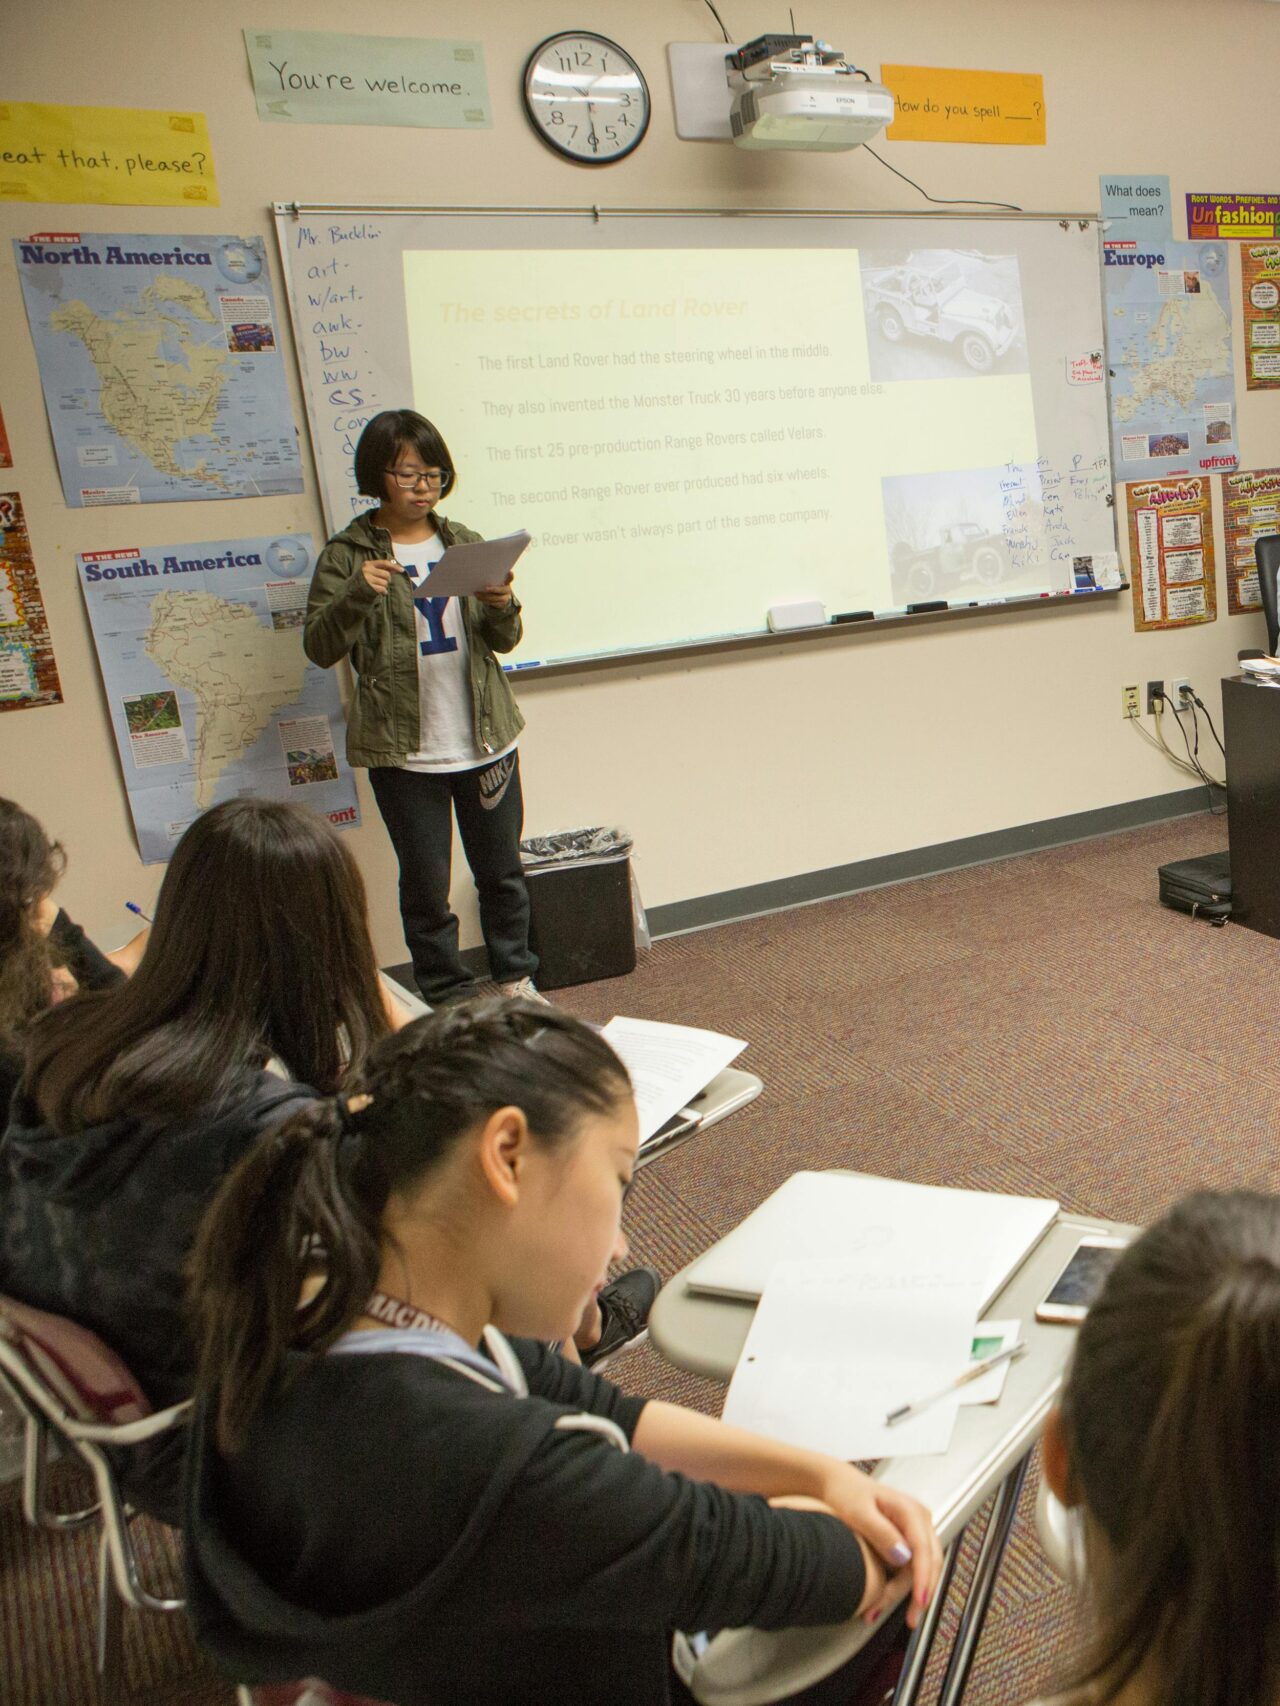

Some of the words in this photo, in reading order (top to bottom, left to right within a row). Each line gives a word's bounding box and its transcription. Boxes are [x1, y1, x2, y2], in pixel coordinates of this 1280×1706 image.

[560, 57, 572, 72] 11
[574, 51, 592, 66] 12
[269, 61, 355, 91] You're
[364, 76, 470, 96] welcome.
[619, 93, 631, 107] 3
[924, 98, 940, 113] do
[945, 106, 968, 120] you
[974, 105, 1000, 122] spell
[551, 111, 564, 125] 8
[618, 113, 627, 126] 4
[567, 125, 578, 138] 7
[605, 125, 617, 139] 5
[0, 147, 47, 164] eat
[126, 152, 206, 176] please?
[1106, 185, 1133, 197] What
[1135, 185, 1161, 197] does
[1191, 195, 1208, 203] ROOT
[1129, 205, 1164, 217] mean?
[20, 246, 102, 265] North
[105, 246, 213, 265] America
[1104, 250, 1165, 268] Europe
[478, 355, 502, 371] The
[506, 355, 534, 370] first
[538, 353, 569, 368] Land
[573, 352, 609, 367] Rover
[613, 351, 636, 366] had
[640, 350, 660, 365] the
[664, 348, 715, 365] steering
[718, 346, 753, 361] wheel
[756, 346, 767, 359] in
[770, 345, 789, 359] the
[792, 344, 833, 358] middle.
[482, 401, 513, 418] They
[518, 400, 546, 415] also
[550, 397, 604, 413] invented
[608, 396, 630, 410] the
[634, 392, 685, 409] Monster
[688, 390, 721, 406] Truck
[725, 389, 741, 404] 30
[743, 388, 776, 405] years
[779, 385, 815, 401] before
[818, 385, 857, 400] anyone
[486, 447, 511, 463] The
[516, 444, 543, 460] first
[546, 442, 565, 458] 25
[569, 437, 661, 460] pre-production
[664, 434, 702, 451] Range
[706, 432, 747, 447] Rovers
[751, 428, 785, 444] called
[1199, 455, 1237, 470] upfront
[491, 491, 516, 506] The
[520, 487, 568, 504] second
[571, 485, 611, 501] Range
[615, 482, 650, 495] Rover
[654, 481, 680, 493] ever
[684, 473, 739, 492] produced
[742, 470, 764, 486] had
[767, 472, 783, 484] six
[96, 553, 112, 561] THE
[114, 551, 139, 559] NEWS
[85, 559, 159, 582] South
[162, 551, 262, 575] America
